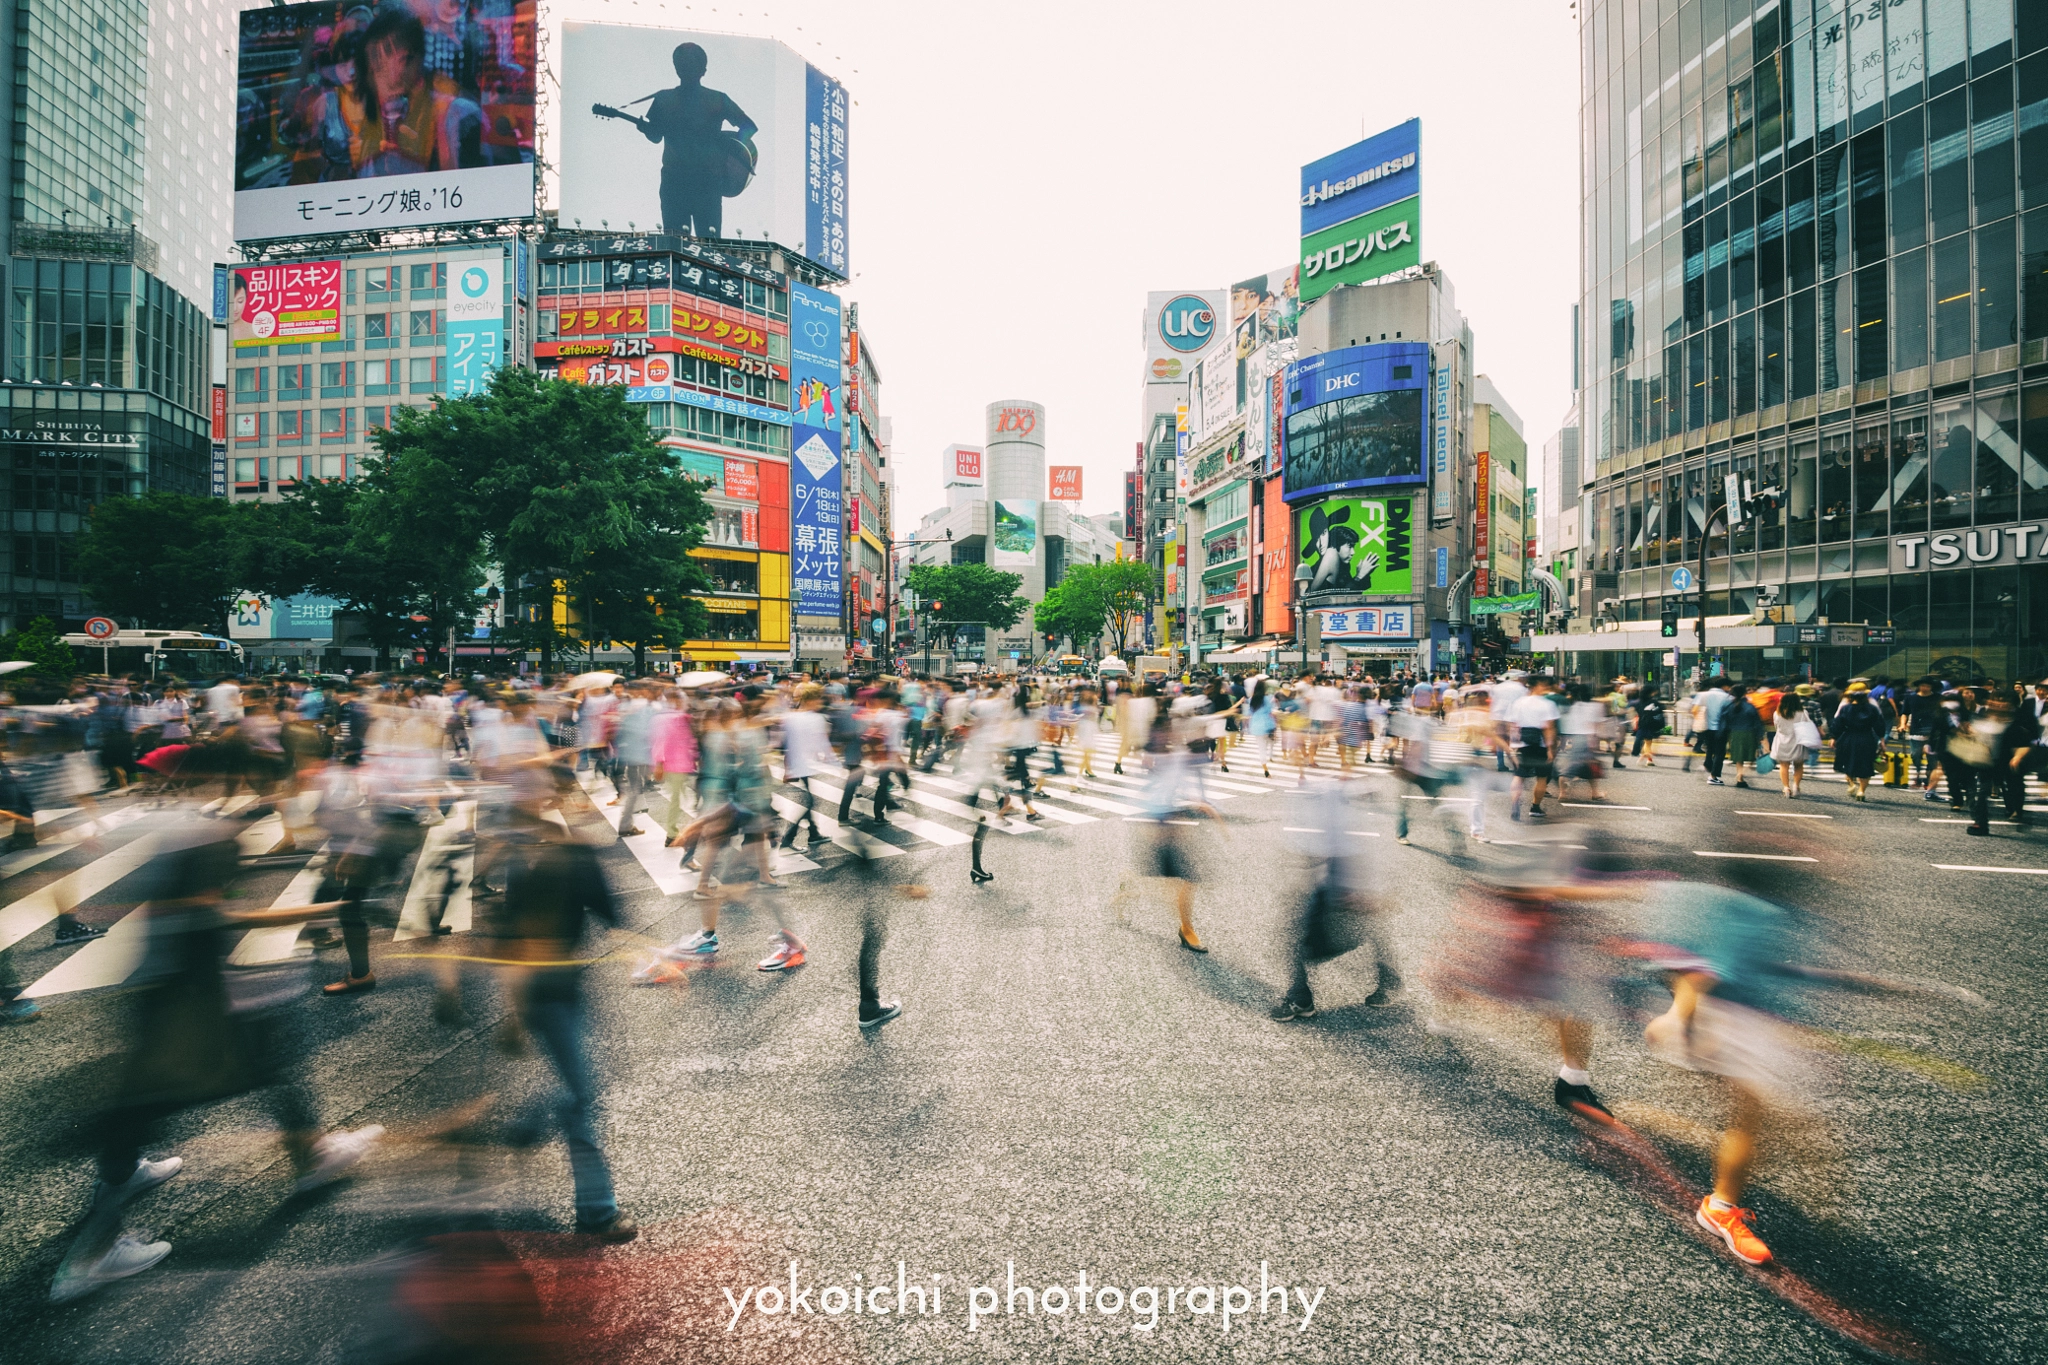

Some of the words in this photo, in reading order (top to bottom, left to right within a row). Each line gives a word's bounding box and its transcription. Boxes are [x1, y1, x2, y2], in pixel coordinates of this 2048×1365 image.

[1300, 152, 1416, 206] Hisamitsu
[549, 242, 589, 256] 月の宴
[608, 238, 648, 252] 月の宴
[1303, 220, 1411, 278] サロンパス
[249, 266, 338, 293] 品川スキン
[612, 262, 667, 280] 月の宴
[682, 267, 739, 297] 月の宴
[249, 287, 337, 313] クリニック
[453, 301, 496, 316] eyecity
[561, 309, 646, 331] プライス
[673, 308, 764, 348] コンタクト
[258, 327, 270, 335] 4F
[612, 339, 655, 356] ガスト
[539, 369, 558, 382] 7F
[562, 367, 586, 378] Café
[587, 363, 640, 386] ガスト
[649, 369, 667, 377] ガスト
[740, 357, 780, 380] ガスト
[1300, 359, 1325, 373] Channel
[1325, 372, 1360, 392] DHC
[1437, 363, 1450, 421] Taisei
[652, 388, 664, 398] 6F
[679, 391, 706, 405] AEON
[713, 398, 789, 422] 英会話イーオン
[2, 429, 72, 441] MARK
[84, 432, 141, 443] CITY
[36, 421, 102, 430] SHIBUYA
[996, 414, 1036, 438] 109
[959, 453, 977, 464] UNI
[1437, 426, 1447, 473] neon
[213, 451, 225, 494] 加藤眼科
[726, 462, 745, 473] 沖縄
[959, 464, 978, 475] QLO
[1055, 470, 1077, 484] H&M
[1478, 454, 1487, 514] クスリのことなら
[1653, 457, 1798, 506] STARBCKS
[1360, 500, 1385, 548] FX
[795, 524, 839, 556] 幕張
[1385, 499, 1411, 573] DMM
[1476, 519, 1487, 555] 三千里
[796, 554, 839, 578] メッセ
[795, 577, 840, 593] 国際展示場
[800, 591, 840, 599] ンディングエディション
[1321, 612, 1405, 632] 堂書店
